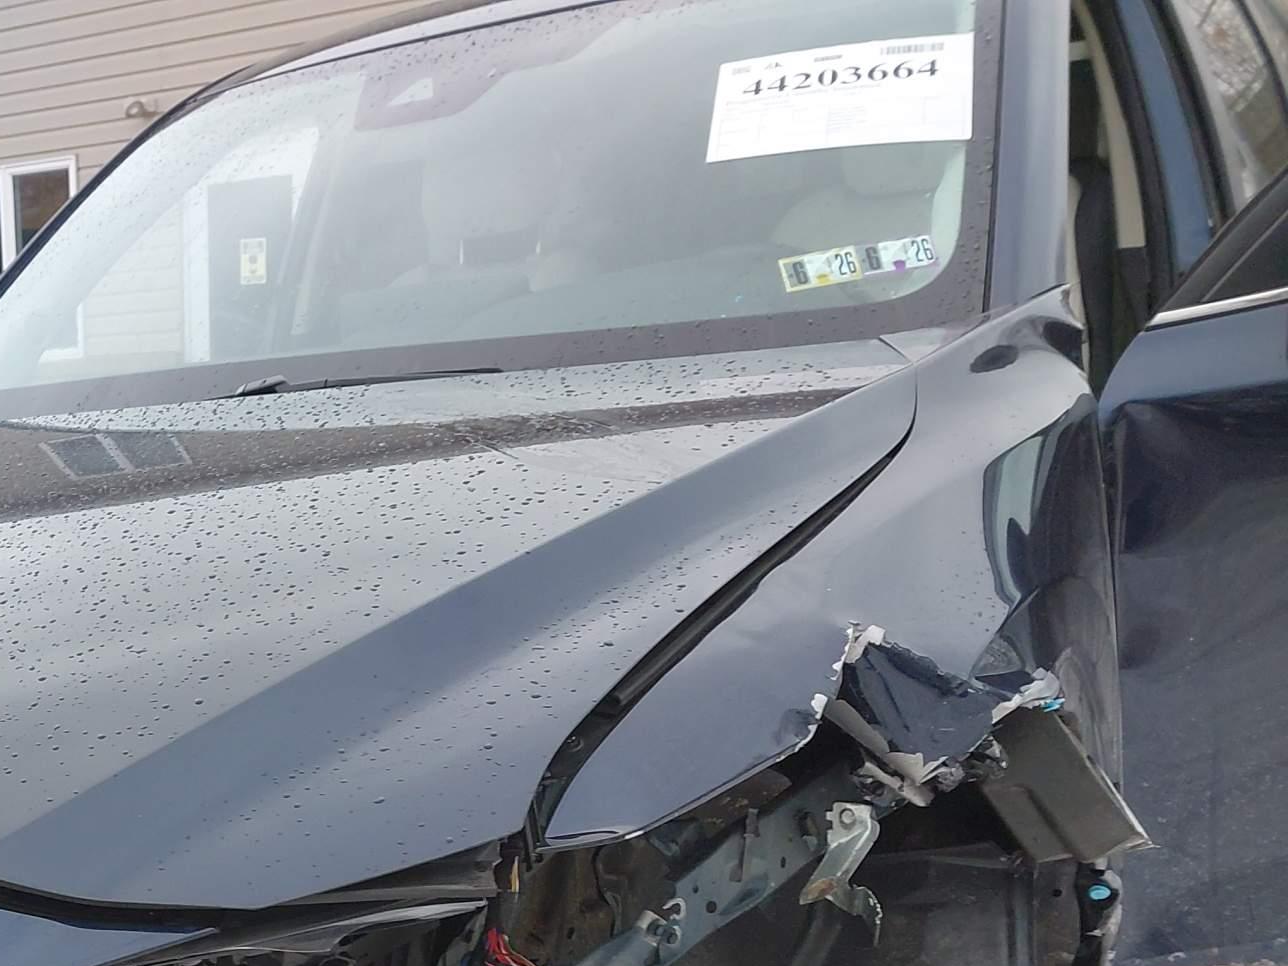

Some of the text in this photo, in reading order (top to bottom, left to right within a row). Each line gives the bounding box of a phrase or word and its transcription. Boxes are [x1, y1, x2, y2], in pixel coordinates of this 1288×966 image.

[742, 59, 940, 96] 44203664
[792, 251, 857, 285] 6 26
[864, 238, 934, 271] 6 26
